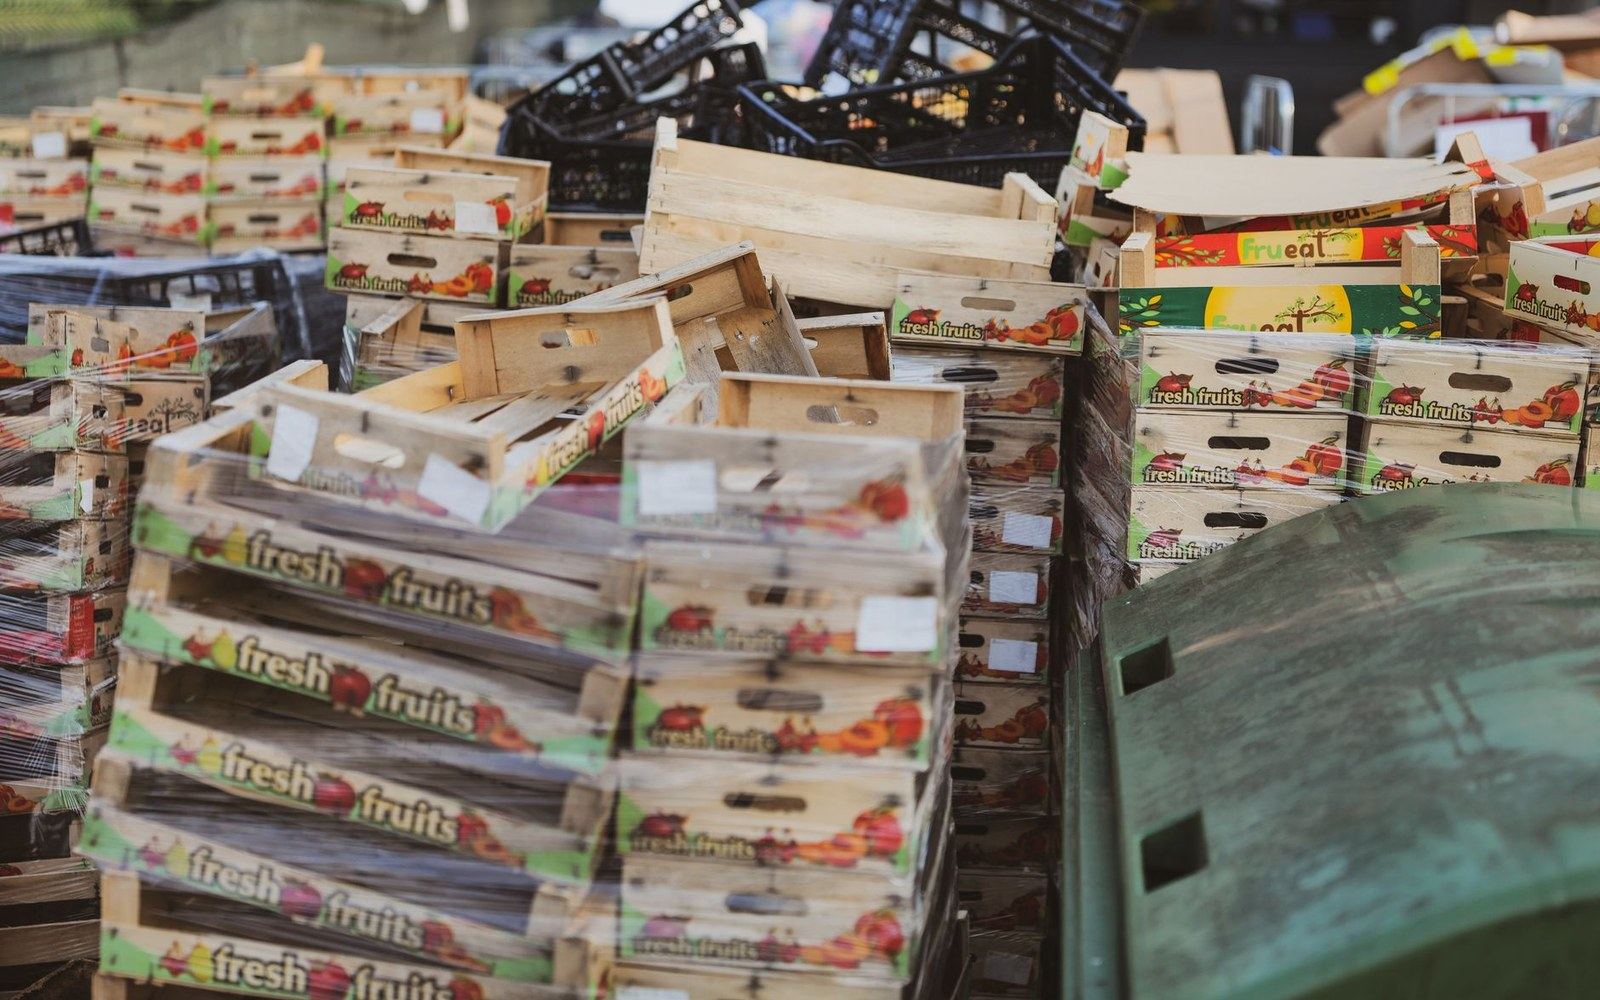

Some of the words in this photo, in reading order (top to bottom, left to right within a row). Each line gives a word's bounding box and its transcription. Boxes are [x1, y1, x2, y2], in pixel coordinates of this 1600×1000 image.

[350, 211, 385, 226] fresh
[387, 211, 428, 230] fruits
[1242, 231, 1326, 260] Frueat
[333, 273, 370, 289] fresh
[371, 275, 407, 293] fruits
[1512, 293, 1538, 315] fresh
[1539, 299, 1569, 323] fruits
[899, 318, 941, 336] fresh
[941, 321, 983, 340] fruits
[1150, 385, 1194, 405] fresh
[1195, 386, 1243, 406] fruits
[1380, 398, 1424, 418] fresh
[1425, 400, 1474, 422] fruits
[547, 421, 589, 481] fresh
[604, 381, 645, 435] fruits
[1143, 465, 1186, 483] fresh
[1187, 465, 1236, 485] fruits
[1371, 473, 1416, 491] fresh
[1138, 541, 1182, 559] fresh
[246, 529, 344, 589] fresh
[389, 565, 491, 624] fruits
[236, 635, 330, 695] fresh
[374, 672, 476, 734] fruits
[645, 722, 709, 749] fresh
[713, 724, 783, 753] fruits
[220, 742, 315, 802] fresh
[360, 785, 459, 845] fruits
[630, 830, 689, 854] fresh
[696, 832, 757, 860] fruits
[188, 845, 282, 906] fresh
[326, 889, 425, 949] fruits
[635, 934, 692, 956] fresh
[698, 936, 758, 960] fruits
[213, 943, 308, 992] fresh
